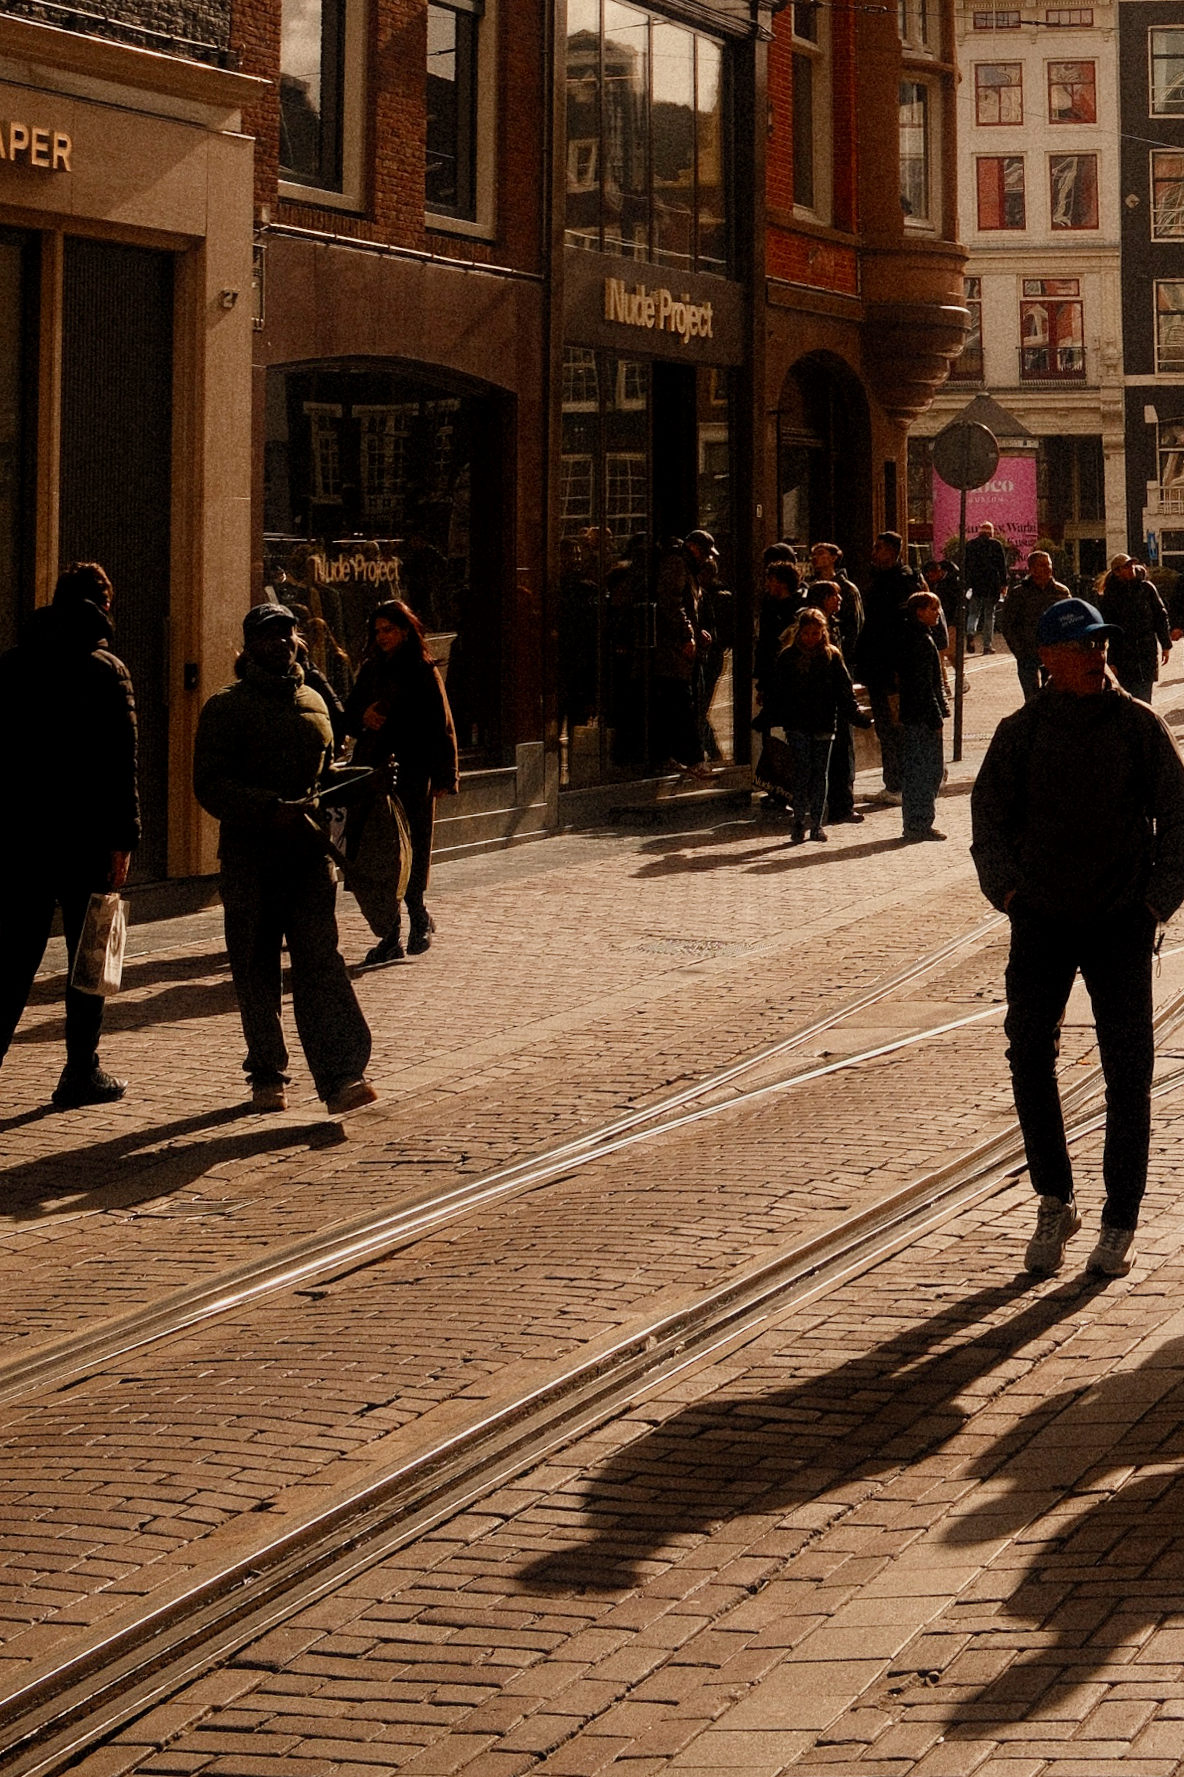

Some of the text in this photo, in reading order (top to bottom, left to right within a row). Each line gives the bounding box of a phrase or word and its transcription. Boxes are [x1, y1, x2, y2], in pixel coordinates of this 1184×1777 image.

[0, 121, 73, 172] PER
[604, 277, 714, 344] Nude Project
[313, 553, 400, 588] Nude Project
